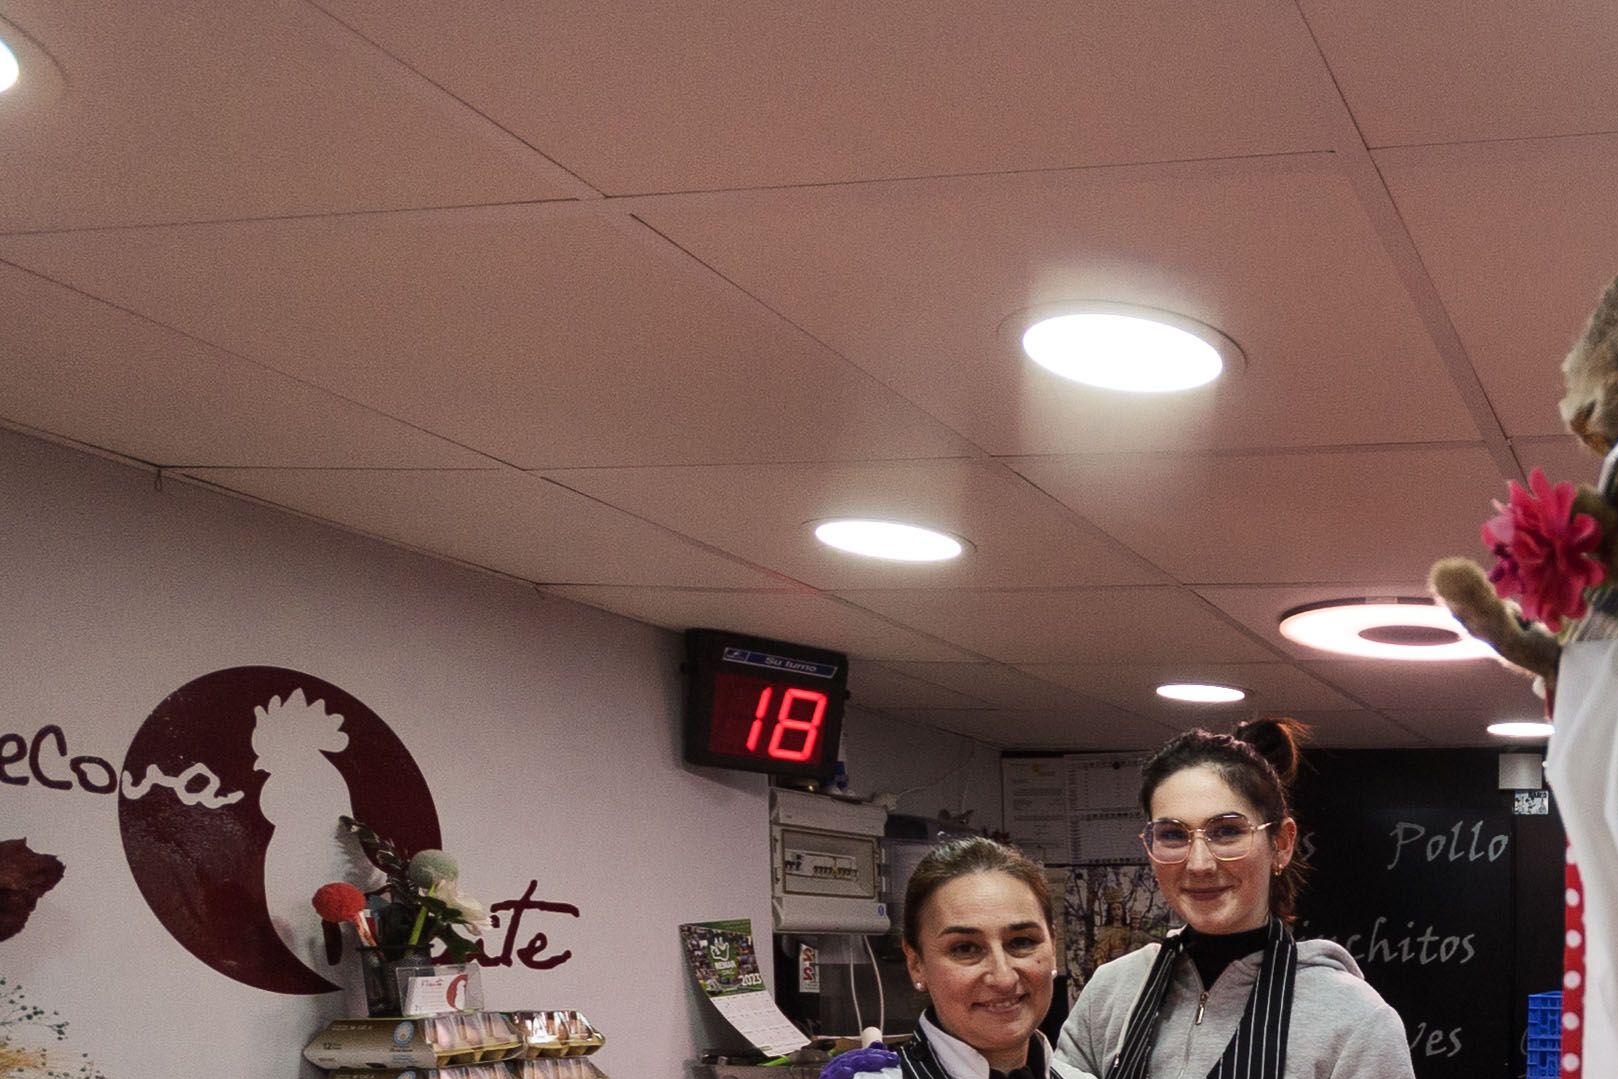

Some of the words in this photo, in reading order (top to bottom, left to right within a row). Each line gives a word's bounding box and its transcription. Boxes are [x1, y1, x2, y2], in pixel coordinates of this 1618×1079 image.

[764, 655, 783, 666] Su
[785, 659, 818, 673] turno
[745, 686, 829, 763] 18
[1386, 819, 1511, 871] Pollo
[738, 972, 762, 986] 2023
